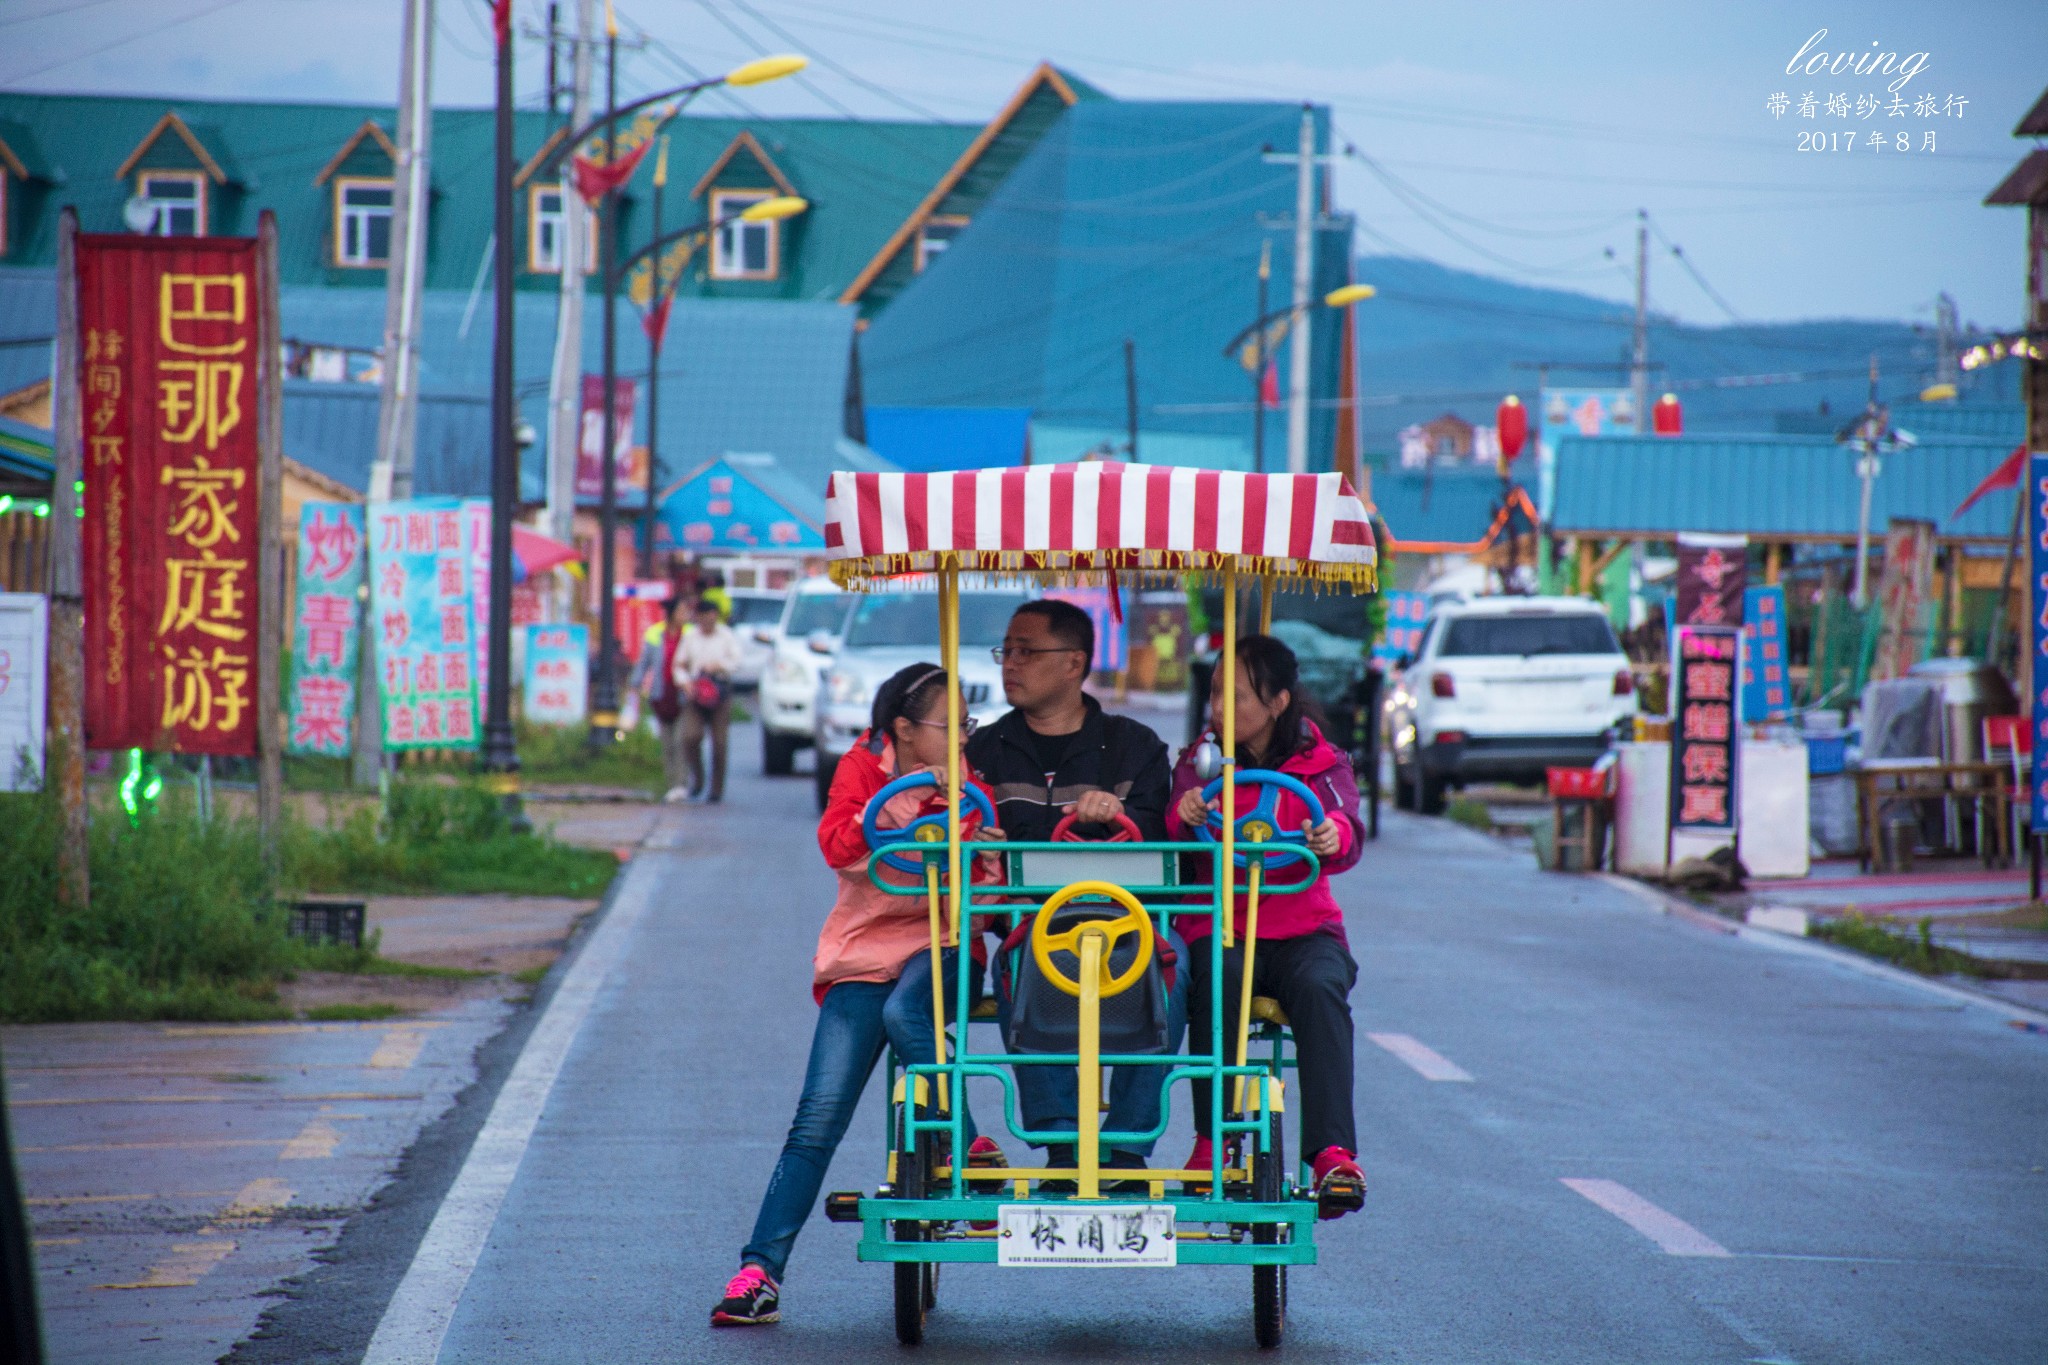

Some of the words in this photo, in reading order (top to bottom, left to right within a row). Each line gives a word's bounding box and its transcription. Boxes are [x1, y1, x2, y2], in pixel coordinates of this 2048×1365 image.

[157, 271, 249, 732] 巴那家庭游
[379, 511, 461, 553] 刀削面
[295, 511, 357, 748] 炒青菜
